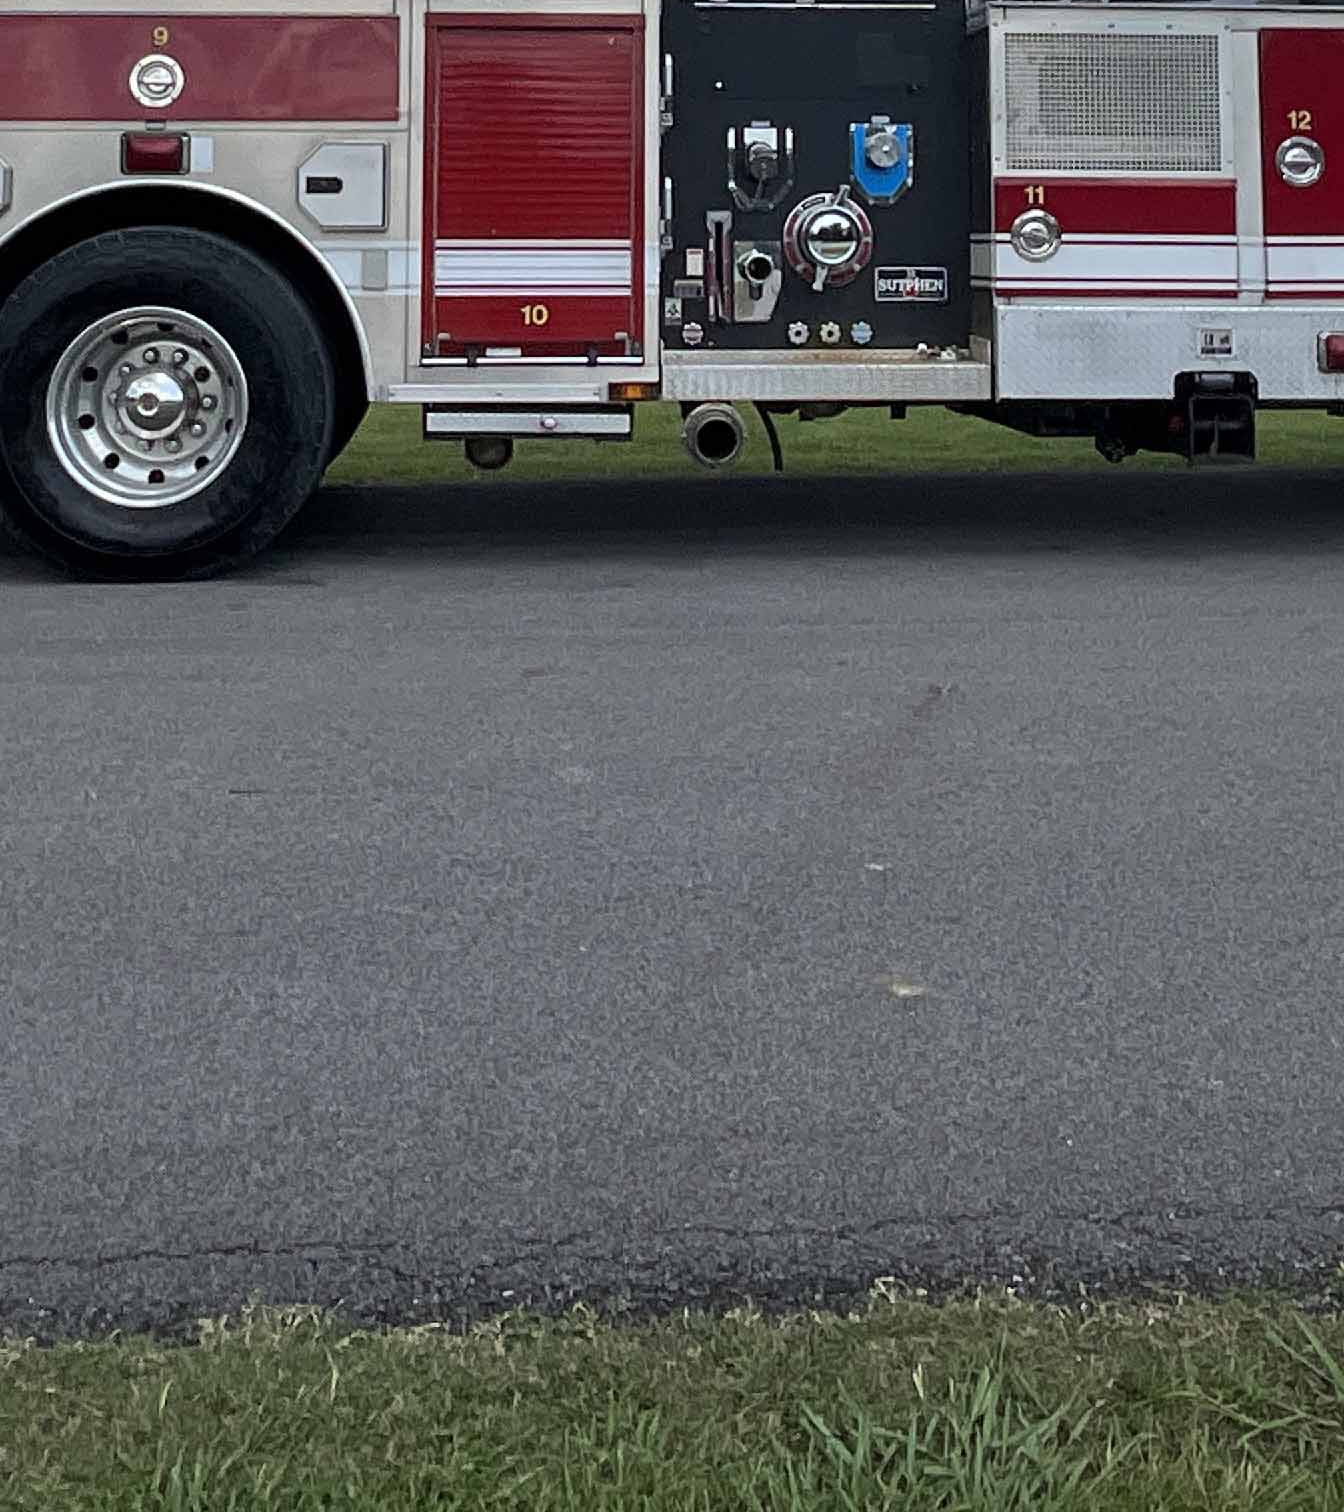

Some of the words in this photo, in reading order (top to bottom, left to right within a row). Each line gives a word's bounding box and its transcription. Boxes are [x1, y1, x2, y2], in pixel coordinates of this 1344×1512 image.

[152, 27, 169, 46] 9
[1287, 110, 1312, 131] 12
[1023, 185, 1045, 205] 11
[878, 278, 944, 292] SUTPHEN
[520, 304, 549, 326] 10
